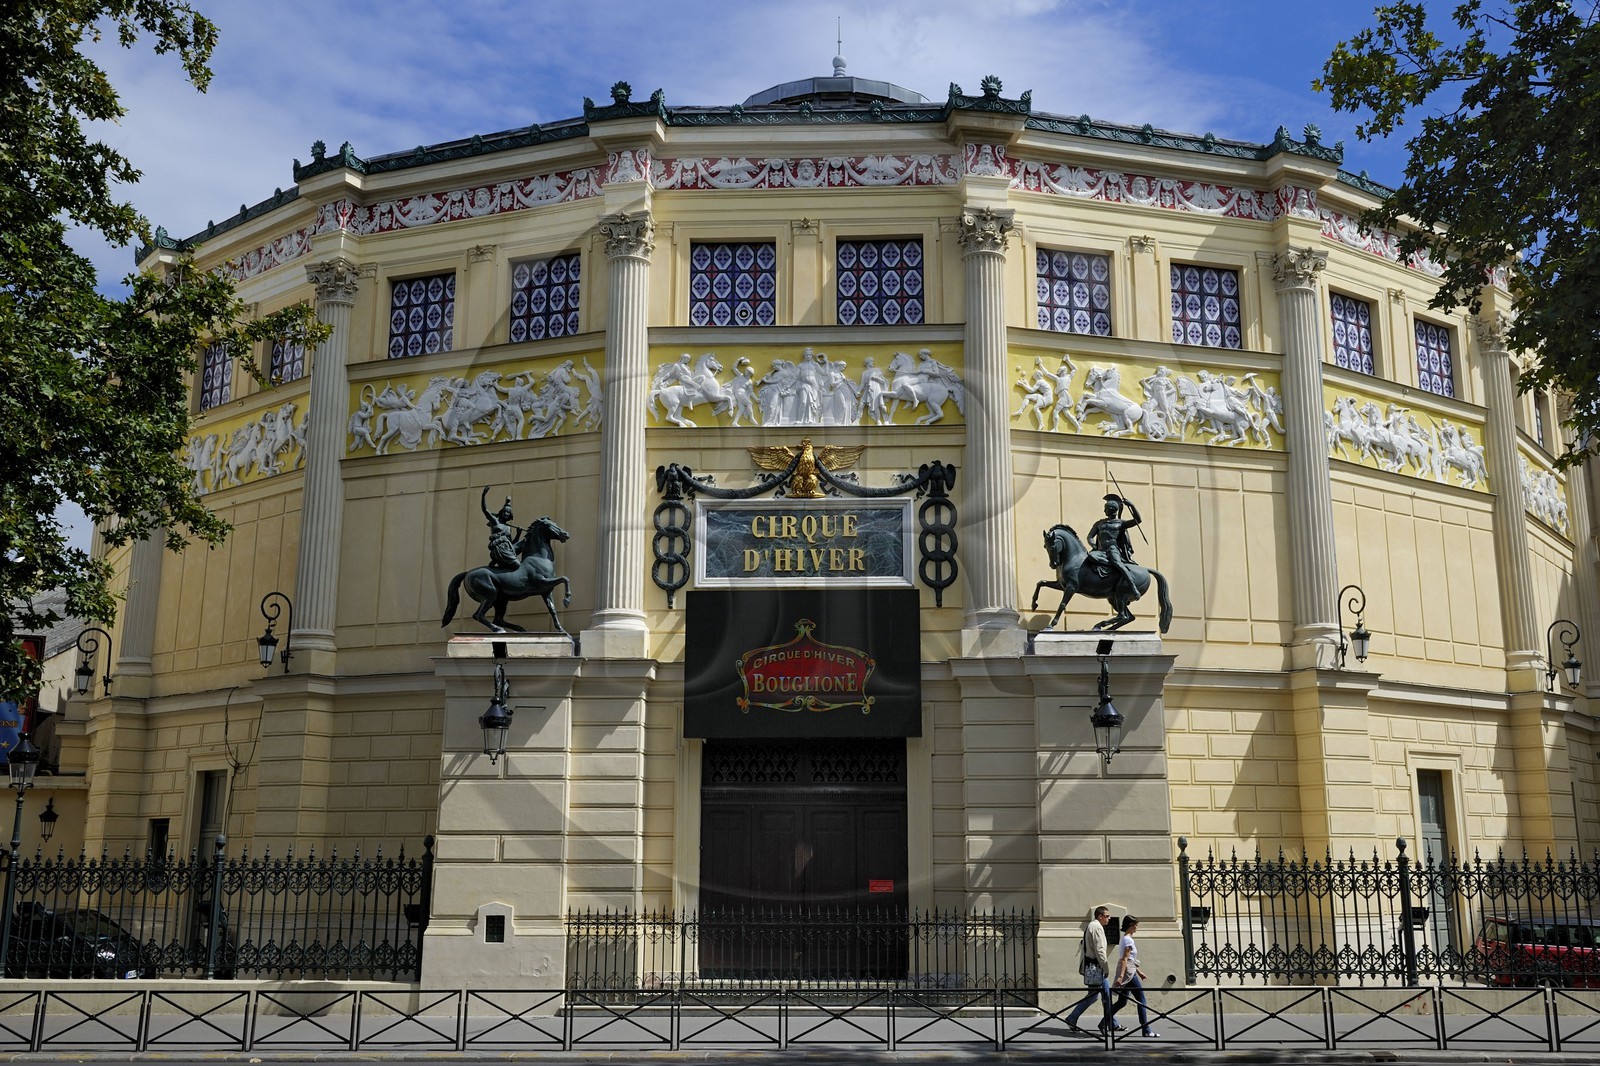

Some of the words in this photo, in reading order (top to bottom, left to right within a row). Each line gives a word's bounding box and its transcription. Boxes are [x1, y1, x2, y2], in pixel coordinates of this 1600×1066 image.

[751, 515, 858, 543] CIRQUE
[743, 548, 865, 572] D'HIVER
[753, 651, 800, 669] CIRQUE
[804, 651, 855, 668] D'HIVER
